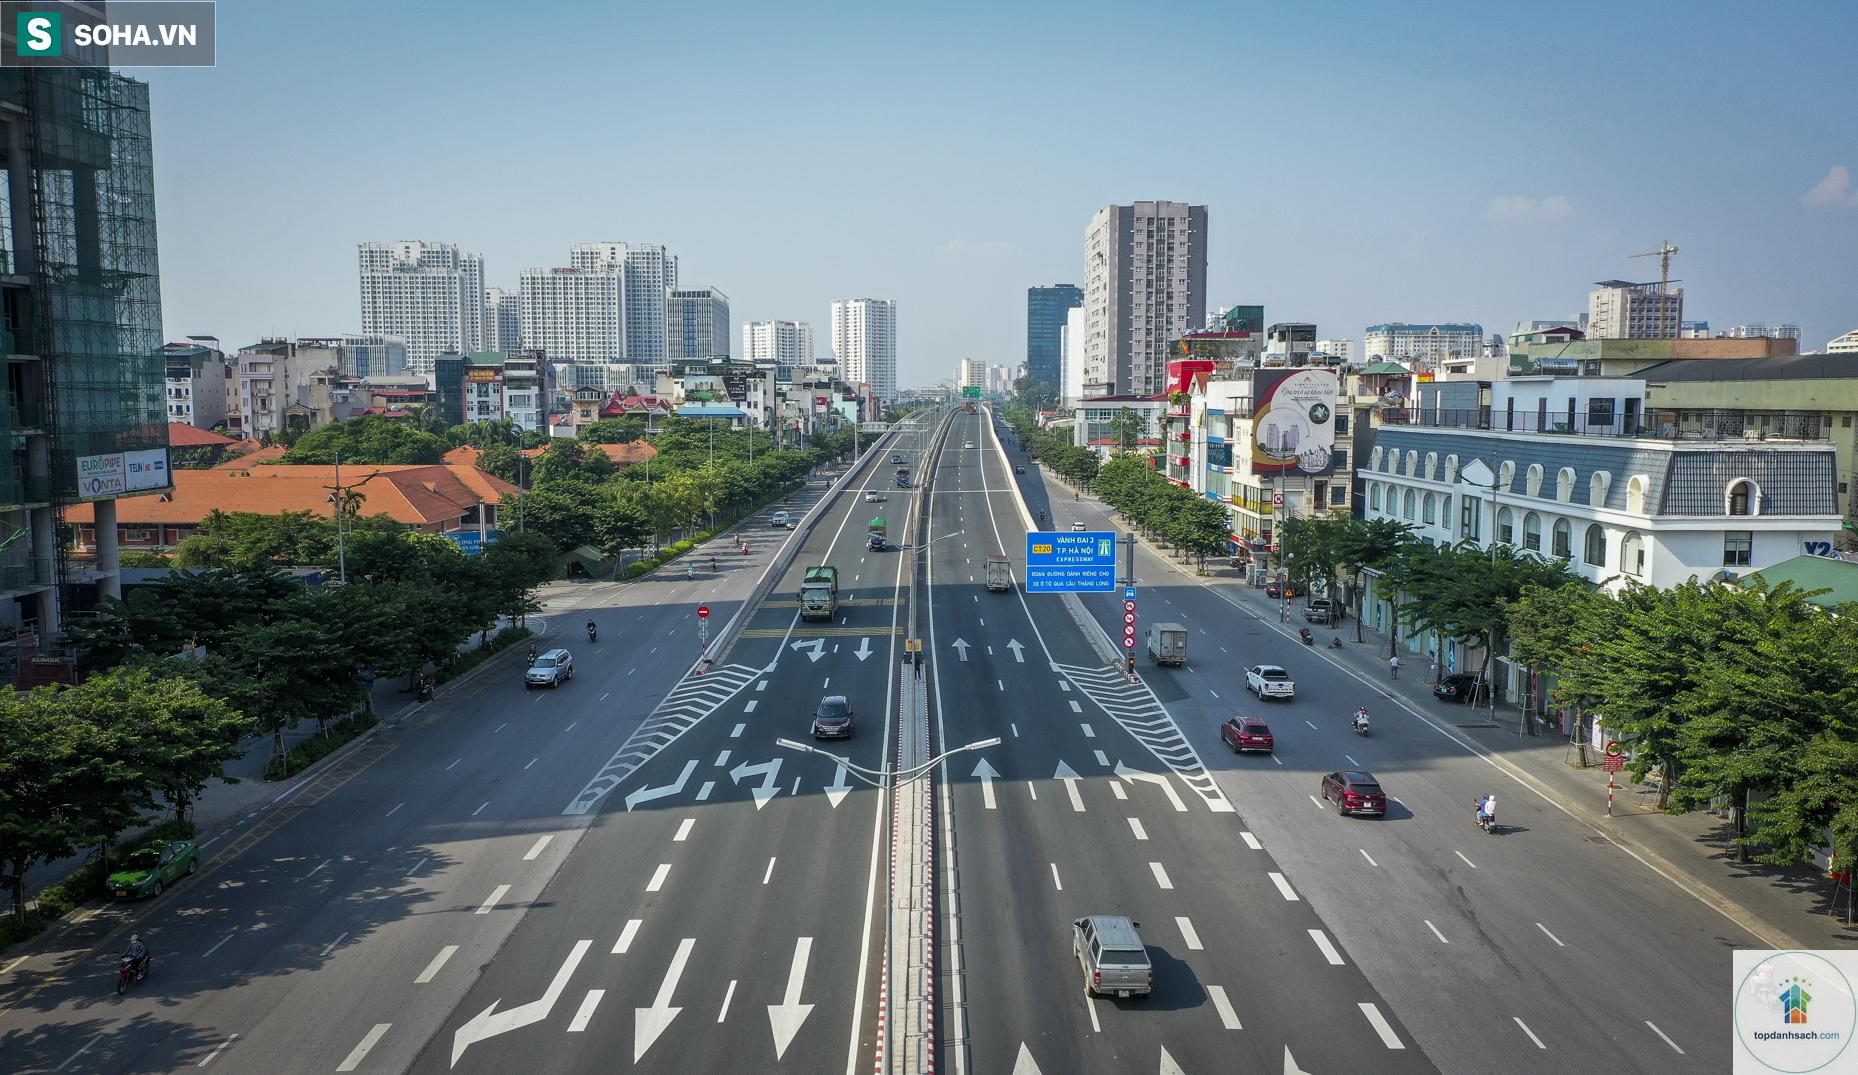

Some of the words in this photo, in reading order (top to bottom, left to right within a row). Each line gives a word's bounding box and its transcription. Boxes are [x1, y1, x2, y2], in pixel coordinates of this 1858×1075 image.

[83, 477, 121, 494] VONTA
[1056, 536, 1076, 544] VÀNH
[1076, 536, 1089, 544] ĐAI
[1033, 545, 1051, 553] CT20
